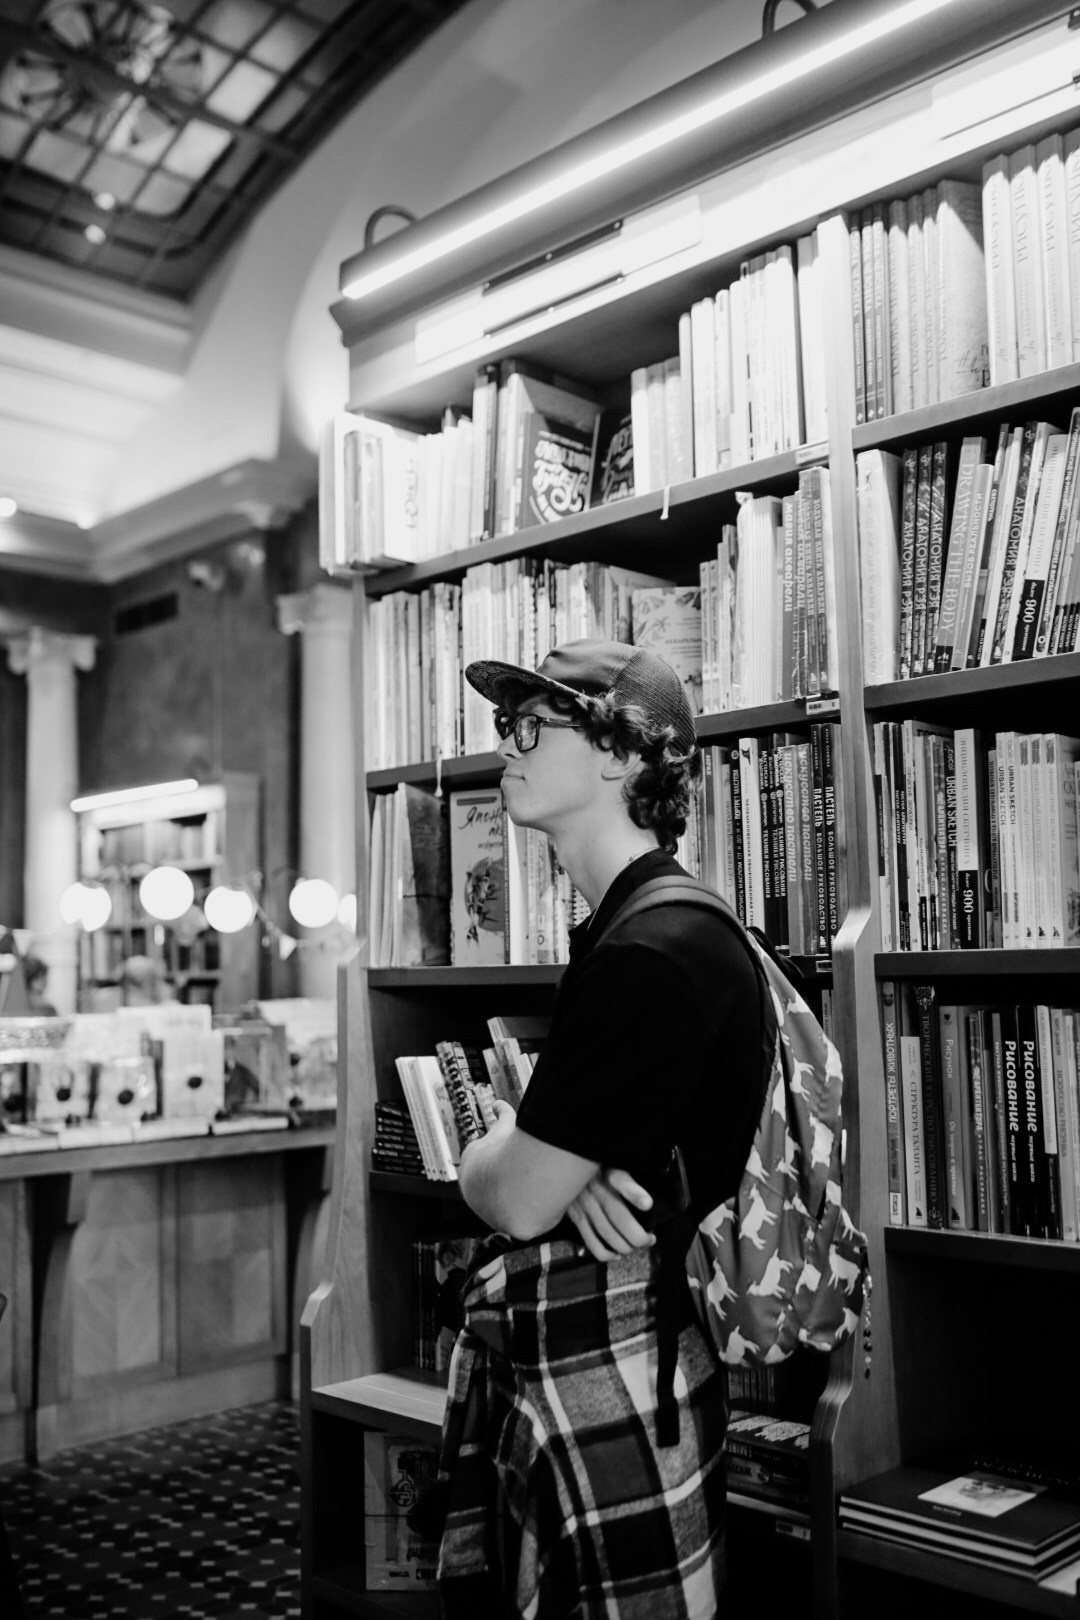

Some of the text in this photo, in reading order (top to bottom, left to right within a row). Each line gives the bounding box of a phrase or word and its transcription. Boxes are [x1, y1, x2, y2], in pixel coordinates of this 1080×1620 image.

[814, 498, 822, 538] БОЛЬШАЯ
[964, 493, 983, 588] ВЫЗОВ РЕАЛЬНОСТИ
[1006, 496, 1025, 564] АНАТОМИЯ
[783, 502, 795, 612] магия акварели
[804, 542, 812, 570] КНИГА
[815, 540, 824, 568] КНИГА
[902, 521, 914, 612] АНАТОМИЯ РЭЯ
[915, 518, 928, 610] АНАТОМИЯ РЭЯ
[928, 512, 942, 608] АНАТОМИЯ РЭЯ
[941, 463, 975, 634] DRAWING THE BODY
[805, 572, 814, 616] АКВАРЕЛИ
[816, 570, 825, 614] АКВАРЕЛИ
[1023, 600, 1038, 623] 900
[998, 766, 1006, 793] URBAN
[1008, 766, 1016, 792] URBAN
[784, 752, 796, 882] искусство пастели
[798, 750, 812, 880] искусство пастели
[825, 786, 834, 826] ПАСТЕЛЬ
[937, 804, 946, 854] АРХИТЕКТУРА
[946, 776, 960, 847] URBAN SKETCH
[999, 795, 1007, 826] SKETCH
[1008, 795, 1016, 826] SKETCH
[813, 788, 826, 931] ПАСТЕЛЬ БОЛЬШОЕ РУКОВОДСТВО
[963, 890, 974, 913] 900
[885, 1022, 898, 1124] ПОРТРЕТЫ ЖИВОТНЫХ
[945, 1039, 954, 1078] Рисунок
[950, 1121, 956, 1132] От
[1004, 1040, 1020, 1132] Рисование
[1023, 1040, 1038, 1132] Рисование
[1056, 1070, 1066, 1118] ИСКУССТВО
[910, 1082, 920, 1132] СТРУКТУРА
[922, 1016, 937, 1202] ТВОРЧЕСКИЙ КУРС ПО РИСОВАНИЮ
[974, 1080, 982, 1131] АРХИТЕКТУРА
[912, 1134, 920, 1175] ТАЛАНТА
